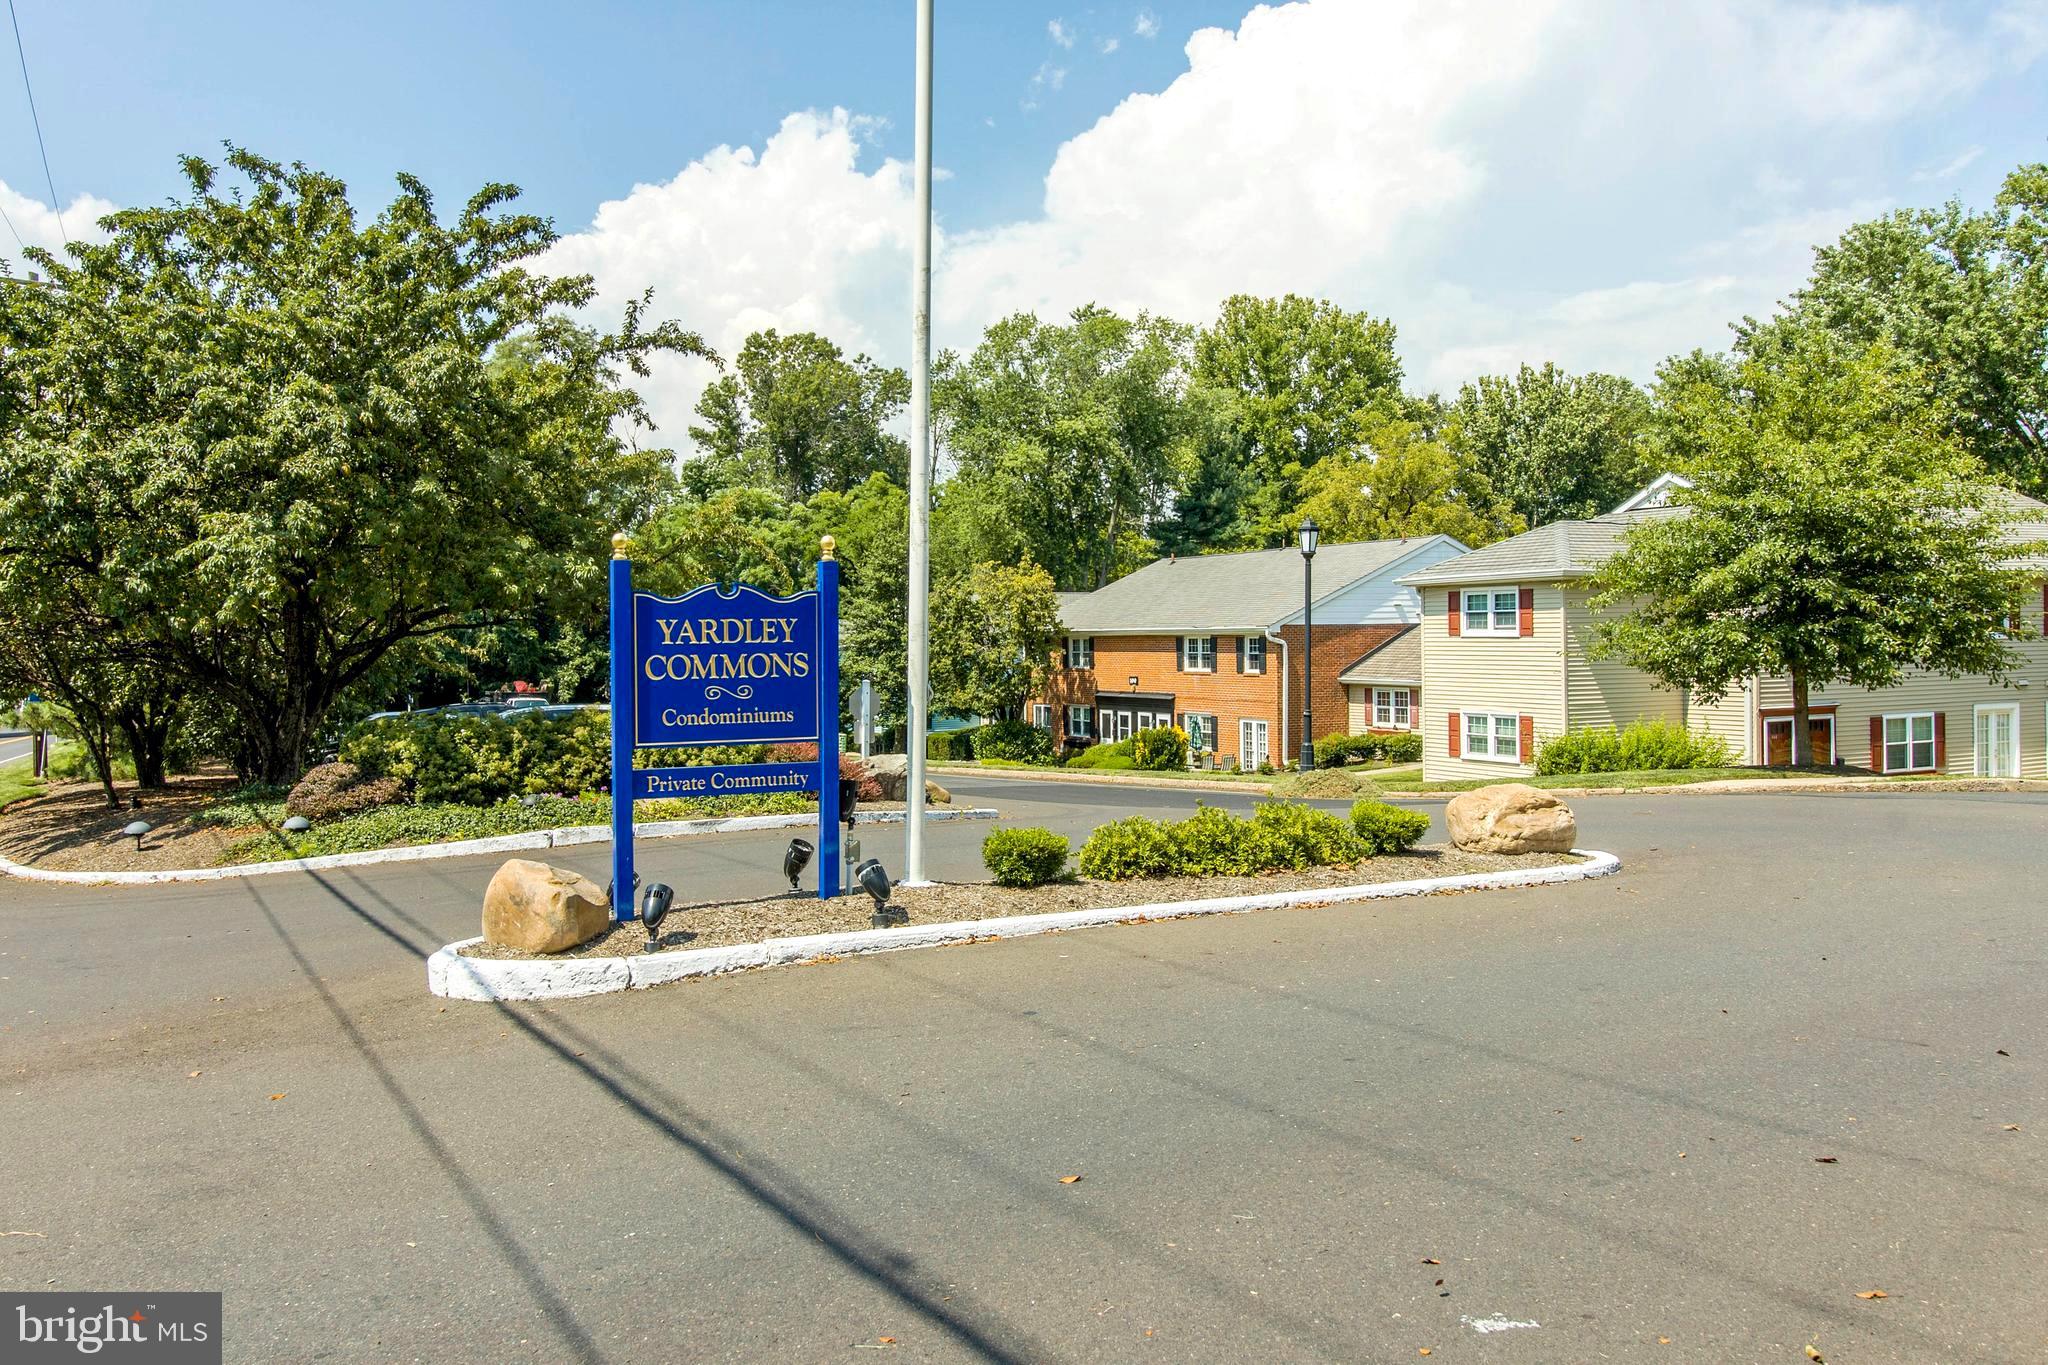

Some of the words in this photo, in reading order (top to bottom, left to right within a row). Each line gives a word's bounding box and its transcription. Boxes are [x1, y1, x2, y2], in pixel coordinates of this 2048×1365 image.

[656, 618, 798, 645] YARDLEY
[644, 652, 809, 681] COMMONS
[661, 706, 794, 727] Condominiums
[646, 774, 706, 793] Private
[710, 770, 809, 791] Community
